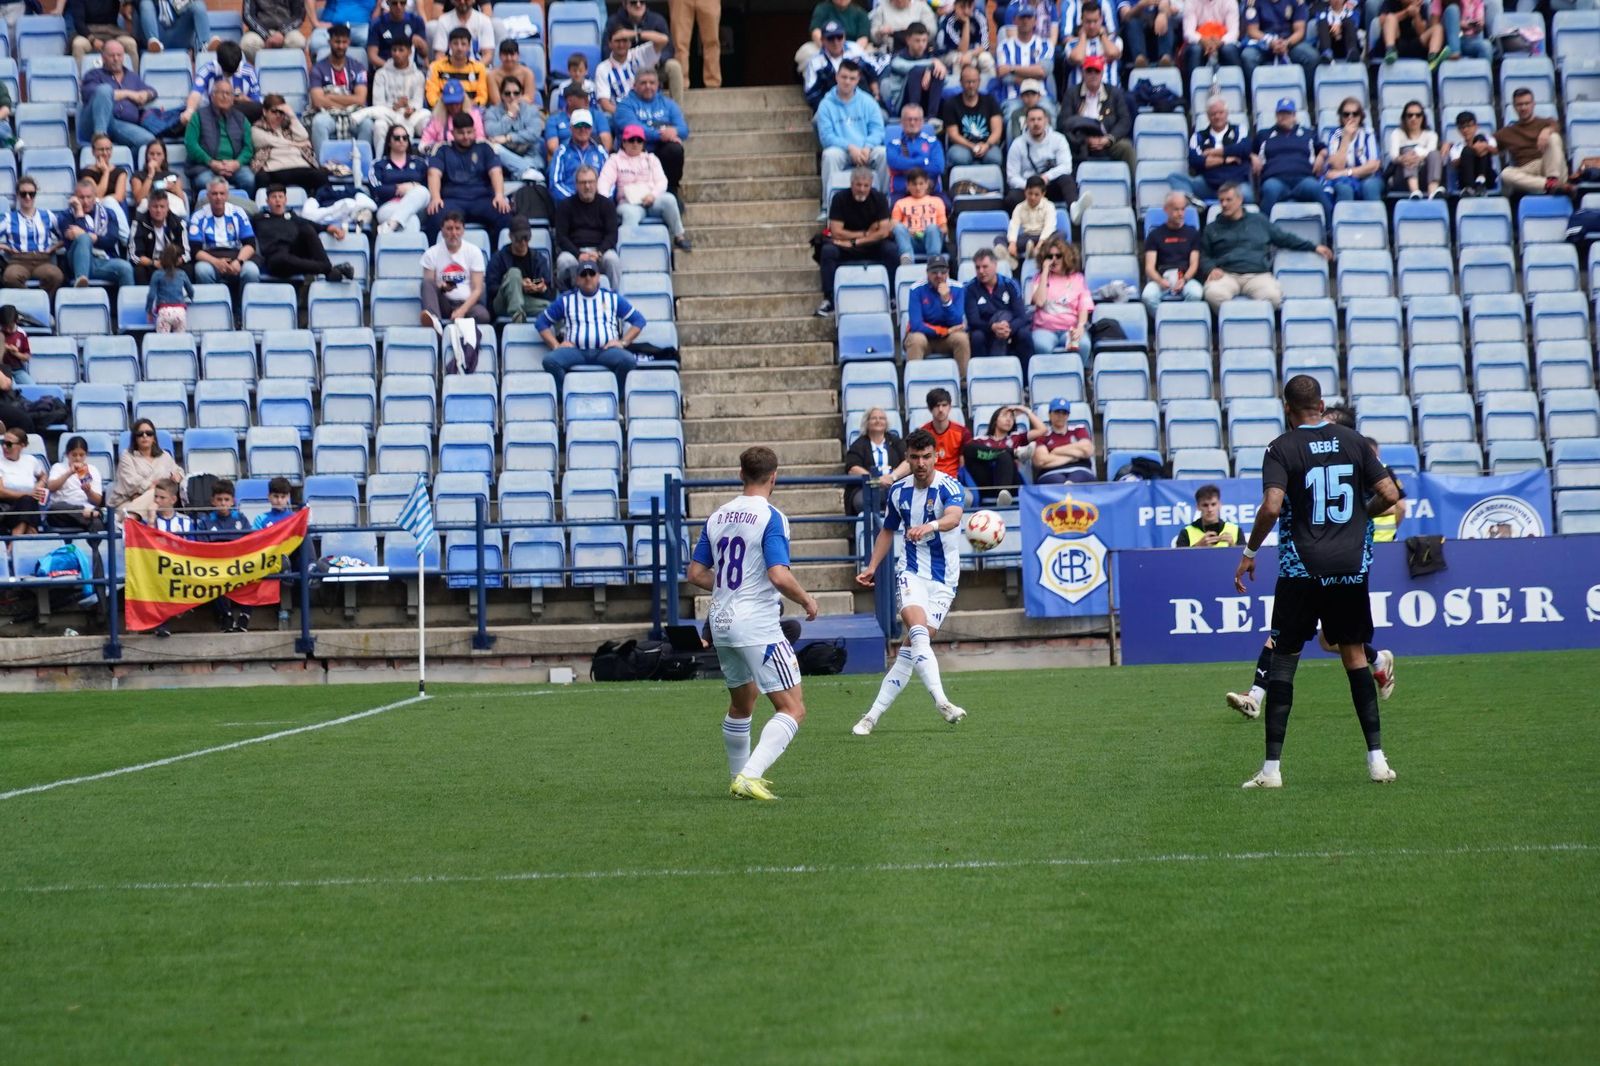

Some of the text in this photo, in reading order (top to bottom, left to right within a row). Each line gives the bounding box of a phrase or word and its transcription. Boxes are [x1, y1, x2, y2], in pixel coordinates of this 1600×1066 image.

[1309, 437, 1340, 454] BEBÉ
[1305, 463, 1354, 525] 15
[157, 553, 277, 577] Palos de la
[716, 535, 746, 590] 18
